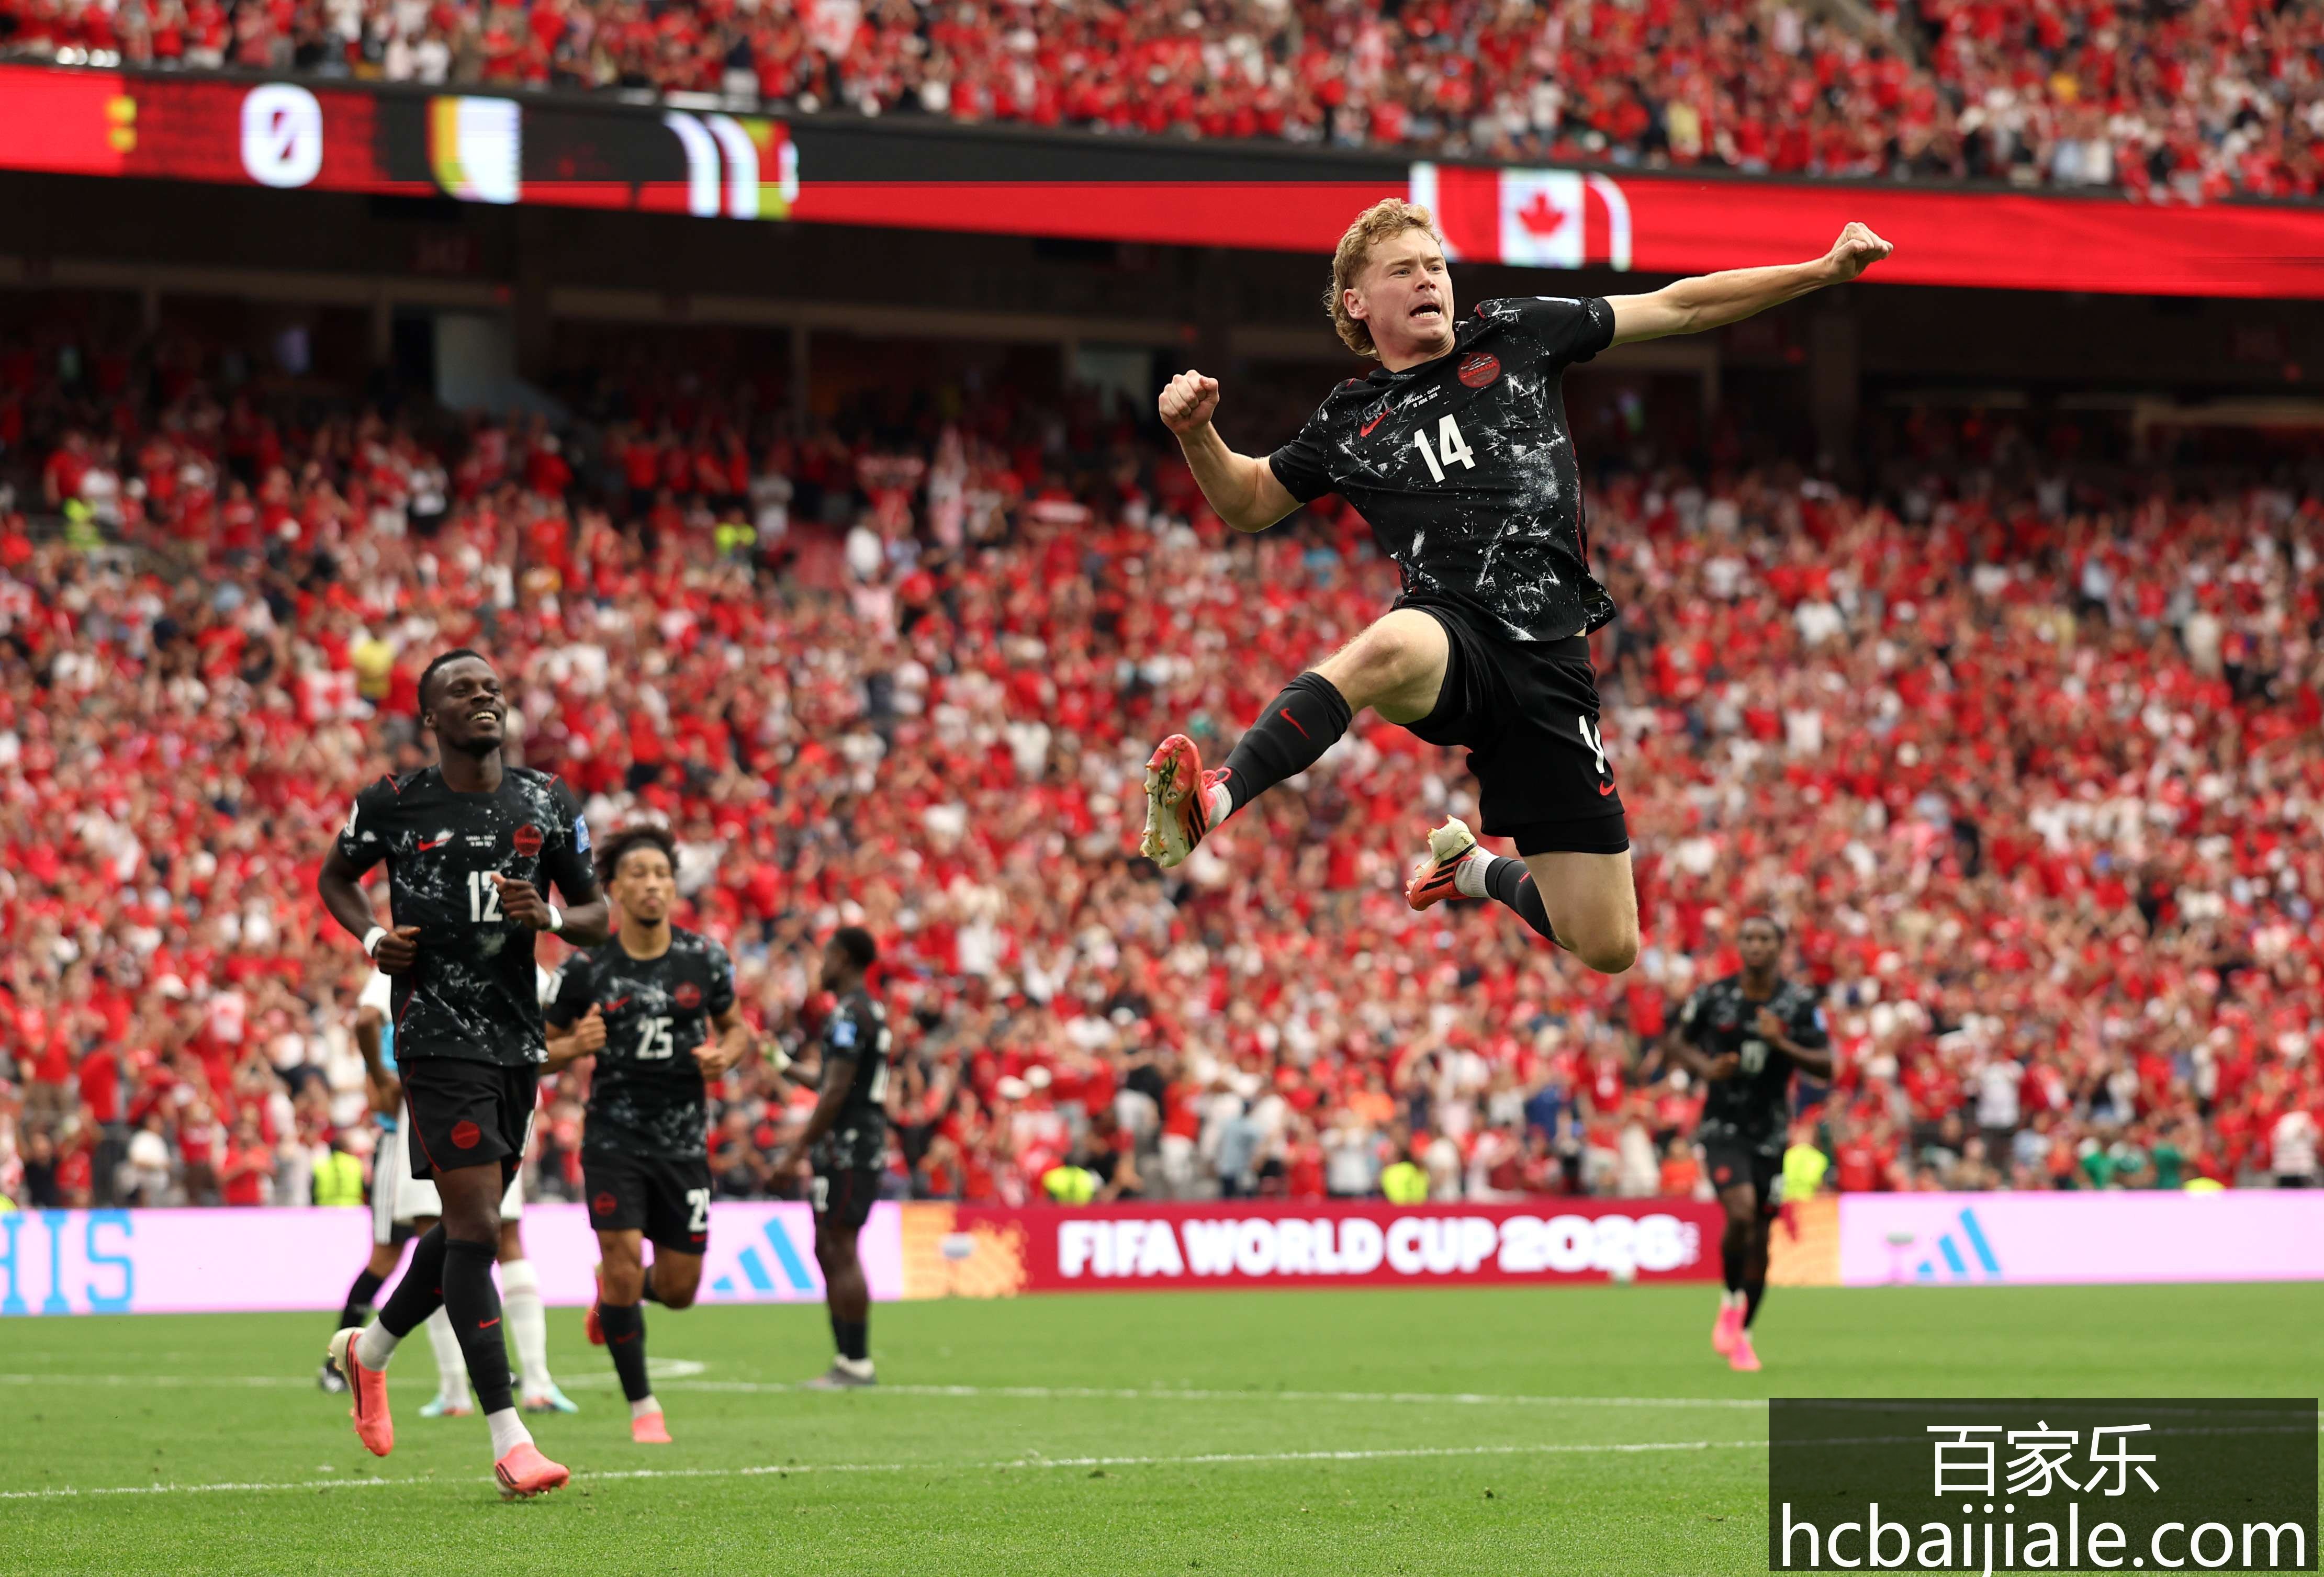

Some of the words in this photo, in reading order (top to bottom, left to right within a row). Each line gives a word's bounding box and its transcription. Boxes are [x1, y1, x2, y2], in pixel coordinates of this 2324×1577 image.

[1427, 385, 1441, 395] QATAR
[1462, 362, 1497, 378] CANADA
[1414, 413, 1476, 483] 14
[467, 871, 503, 922] 12
[636, 1017, 674, 1060] 25
[1058, 1219, 1184, 1277] FIFA
[1181, 1218, 1385, 1276] WORLD
[1385, 1216, 1498, 1274] CUP
[1498, 1213, 1685, 1274] 2026
